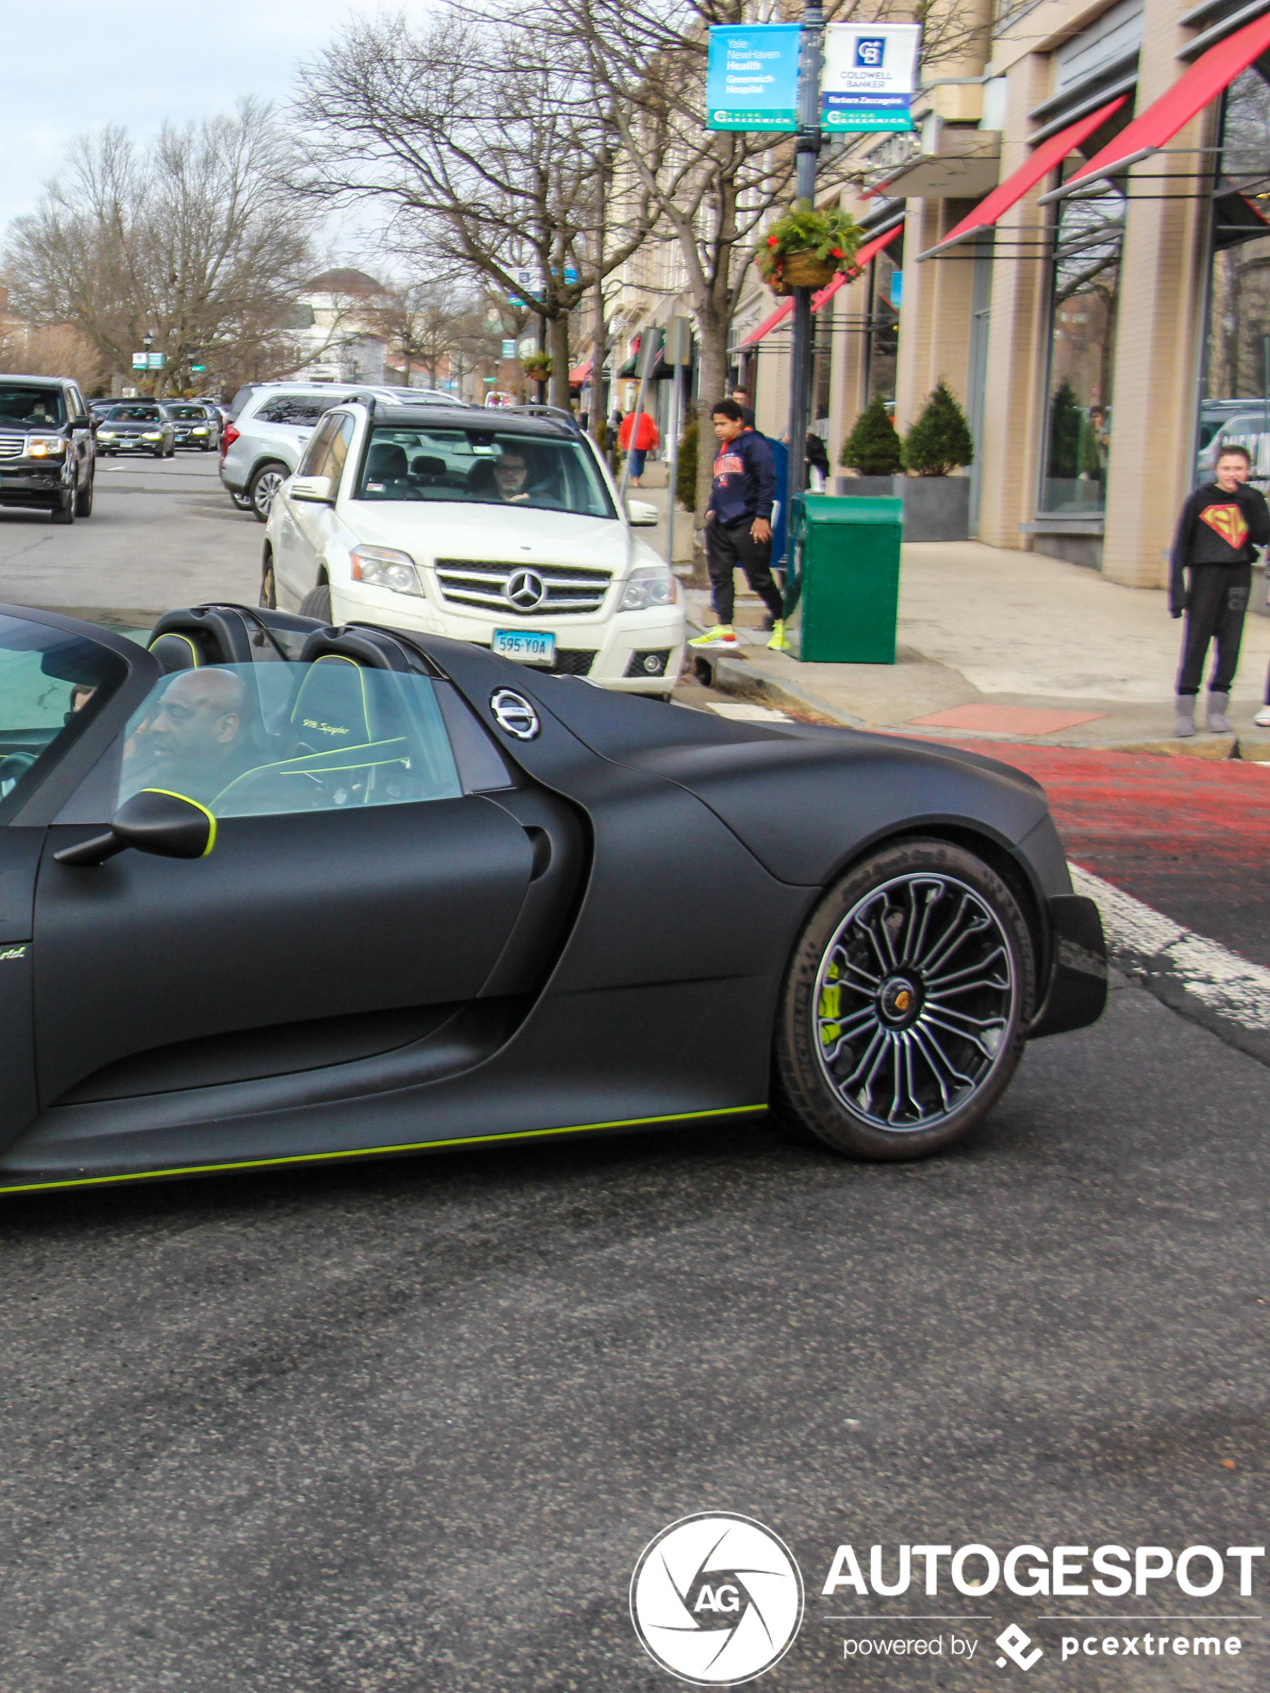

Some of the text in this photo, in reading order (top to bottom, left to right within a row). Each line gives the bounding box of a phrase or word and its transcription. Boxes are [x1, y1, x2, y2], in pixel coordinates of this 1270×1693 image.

[727, 39, 747, 49] Yale
[726, 61, 761, 71] Health
[726, 74, 774, 84] Greenwich
[840, 71, 893, 80] COLDWELL
[846, 80, 886, 88] BANKER
[725, 85, 764, 95] Hospital
[828, 96, 858, 104] Barbara
